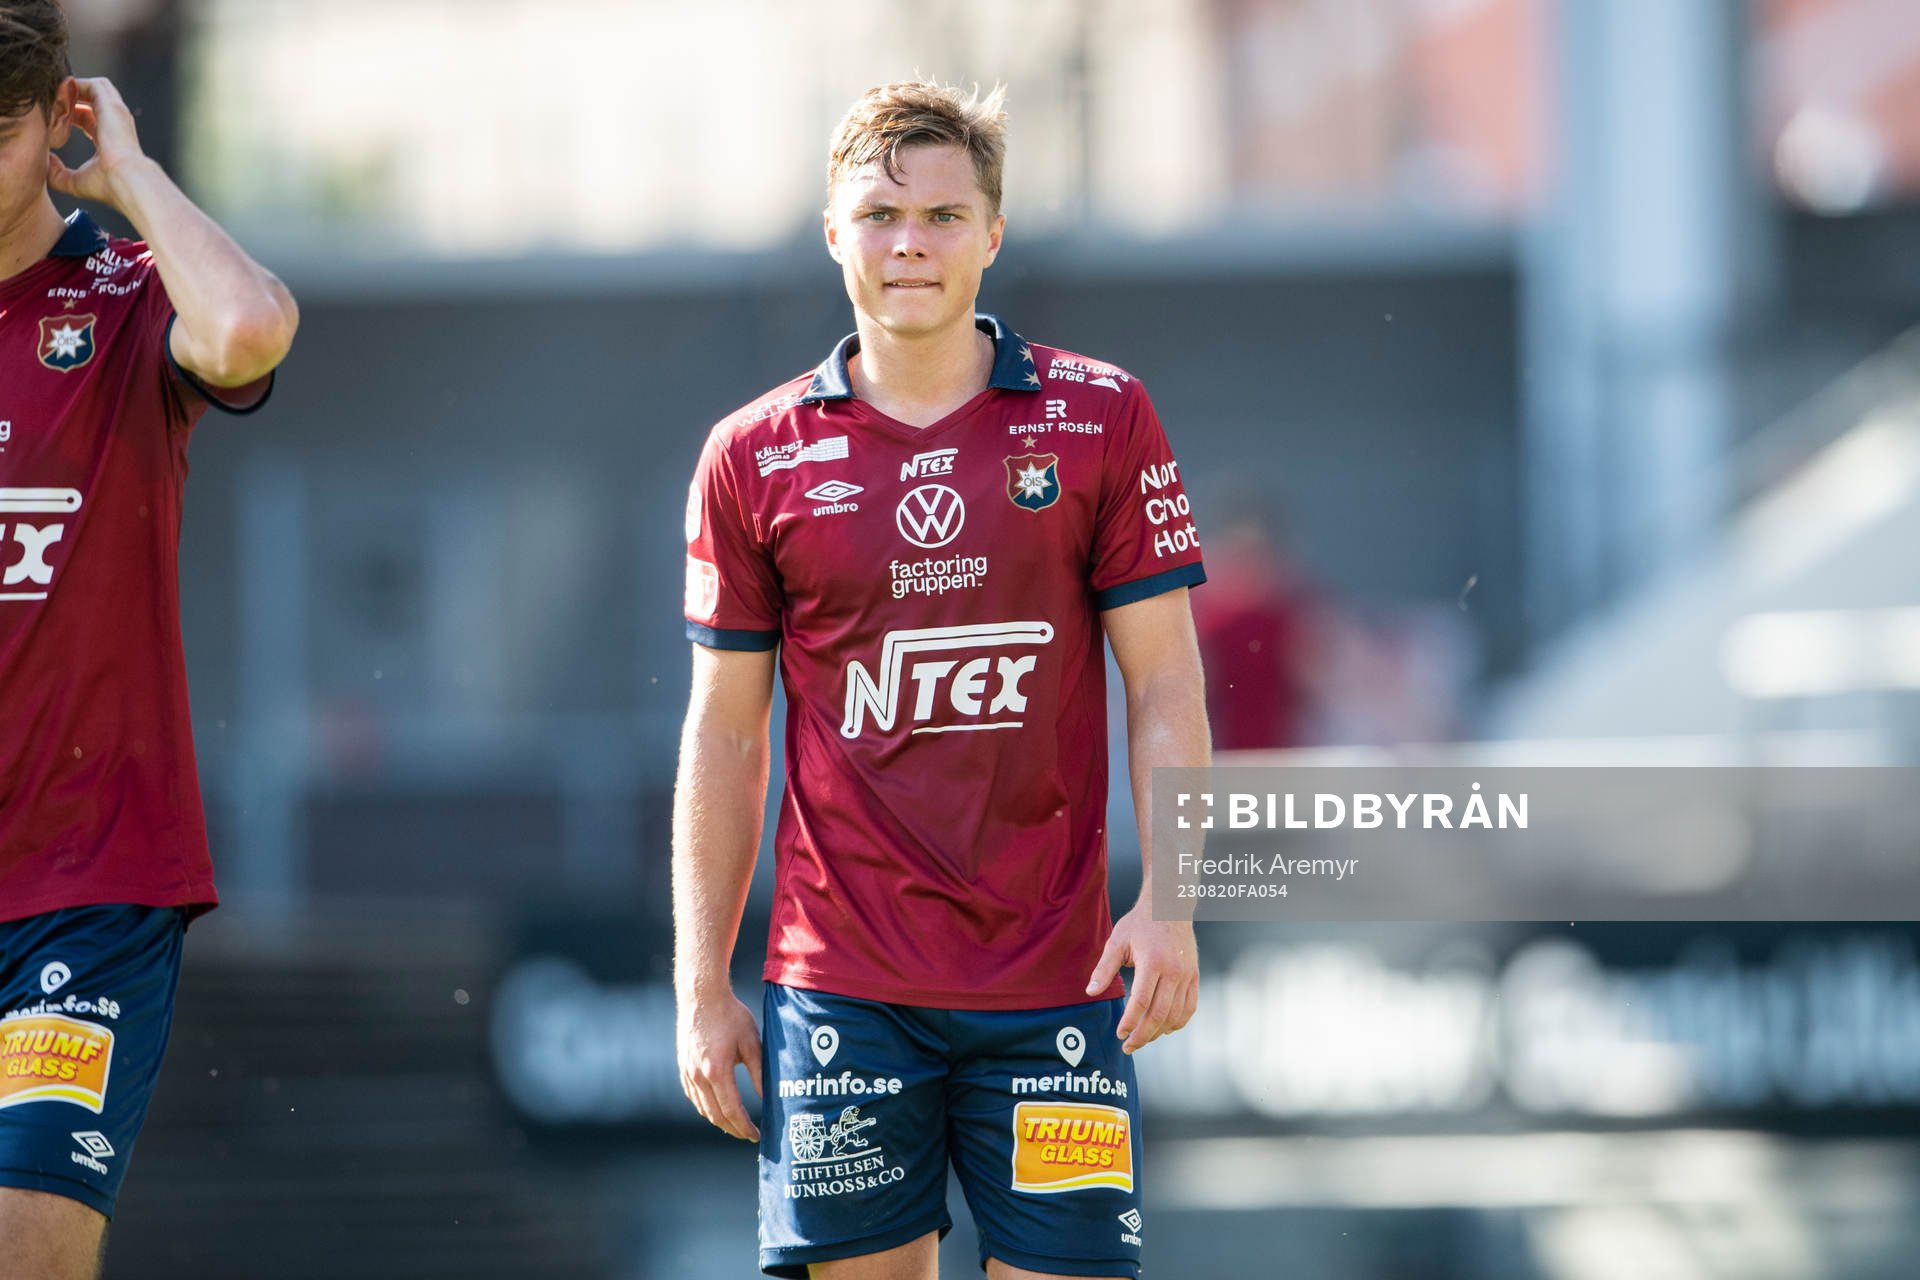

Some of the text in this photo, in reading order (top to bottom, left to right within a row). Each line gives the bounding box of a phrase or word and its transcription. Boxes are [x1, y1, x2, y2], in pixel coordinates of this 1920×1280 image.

[47, 287, 88, 299] ERNS
[1048, 368, 1086, 383] BYGG
[1009, 421, 1103, 435] ERNST ROSÉN
[900, 448, 958, 481] NTEX
[813, 501, 858, 516] umbro
[889, 554, 987, 579] factoring
[840, 621, 1054, 739] NTEX
[2, 1029, 102, 1063] TRIUMF
[7, 1056, 77, 1081] GLASS
[779, 1071, 903, 1098] merinfo.se
[1012, 1070, 1127, 1098] merinfo.se
[1024, 1117, 1126, 1148] TRIUMF
[71, 1151, 108, 1175] umbro
[791, 1155, 885, 1181] STIFTELSEN
[1040, 1144, 1113, 1168] GLASS
